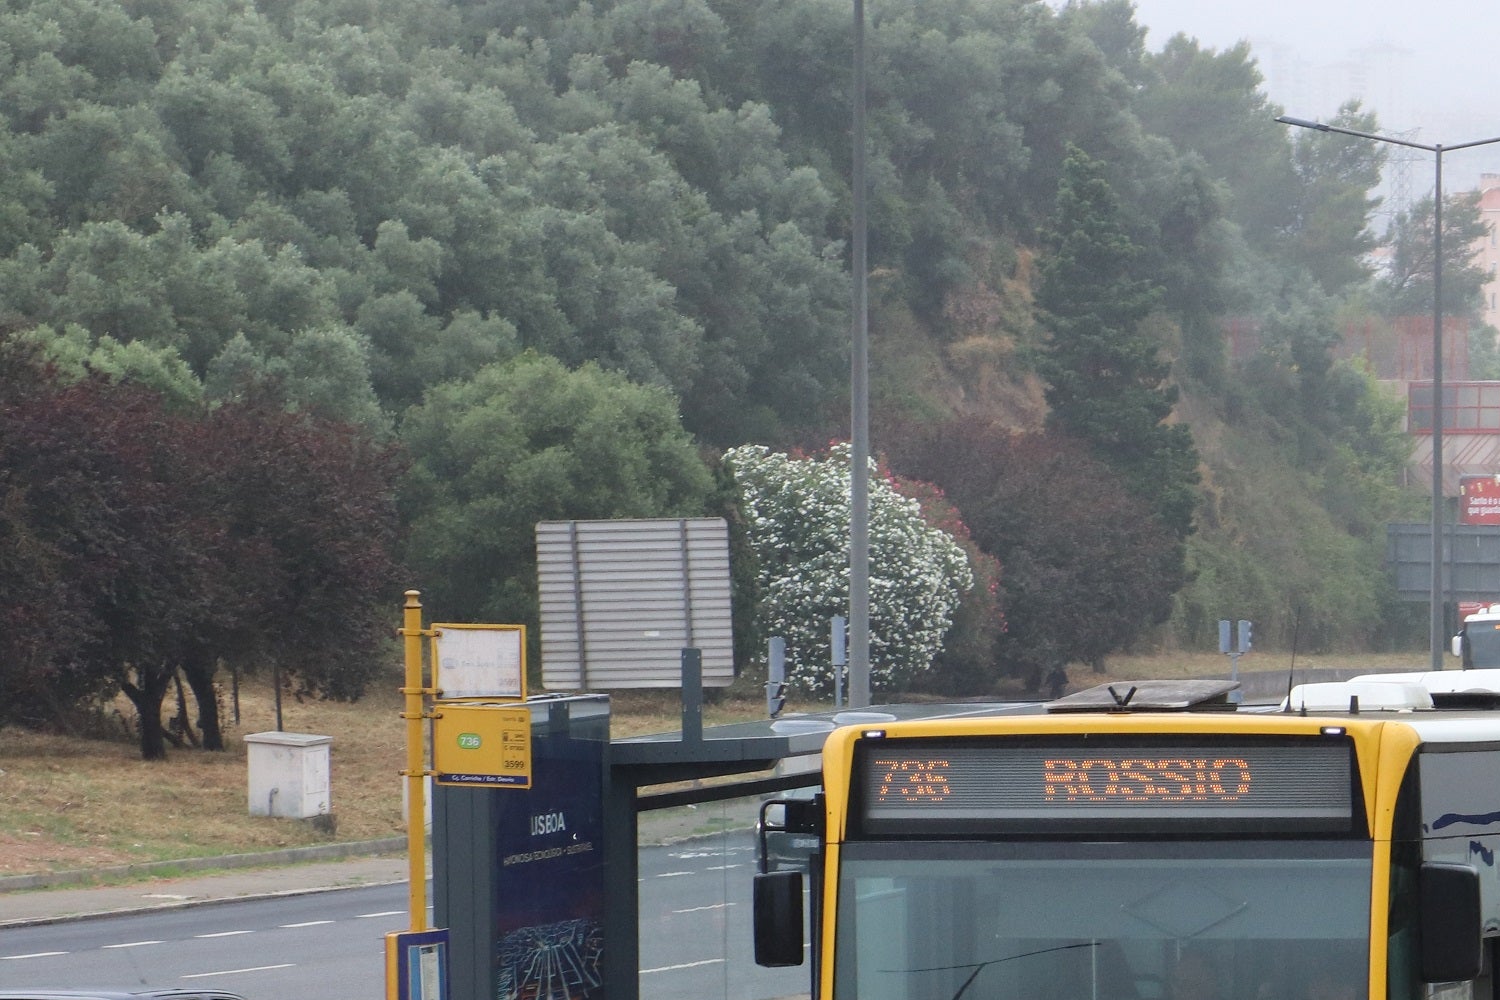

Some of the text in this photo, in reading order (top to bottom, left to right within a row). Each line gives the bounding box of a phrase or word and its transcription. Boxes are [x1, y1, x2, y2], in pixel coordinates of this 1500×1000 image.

[460, 736, 480, 746] 736
[504, 760, 525, 769] 3599
[874, 759, 1251, 802] 736 ROSSIO
[530, 811, 566, 836] LISBOA
